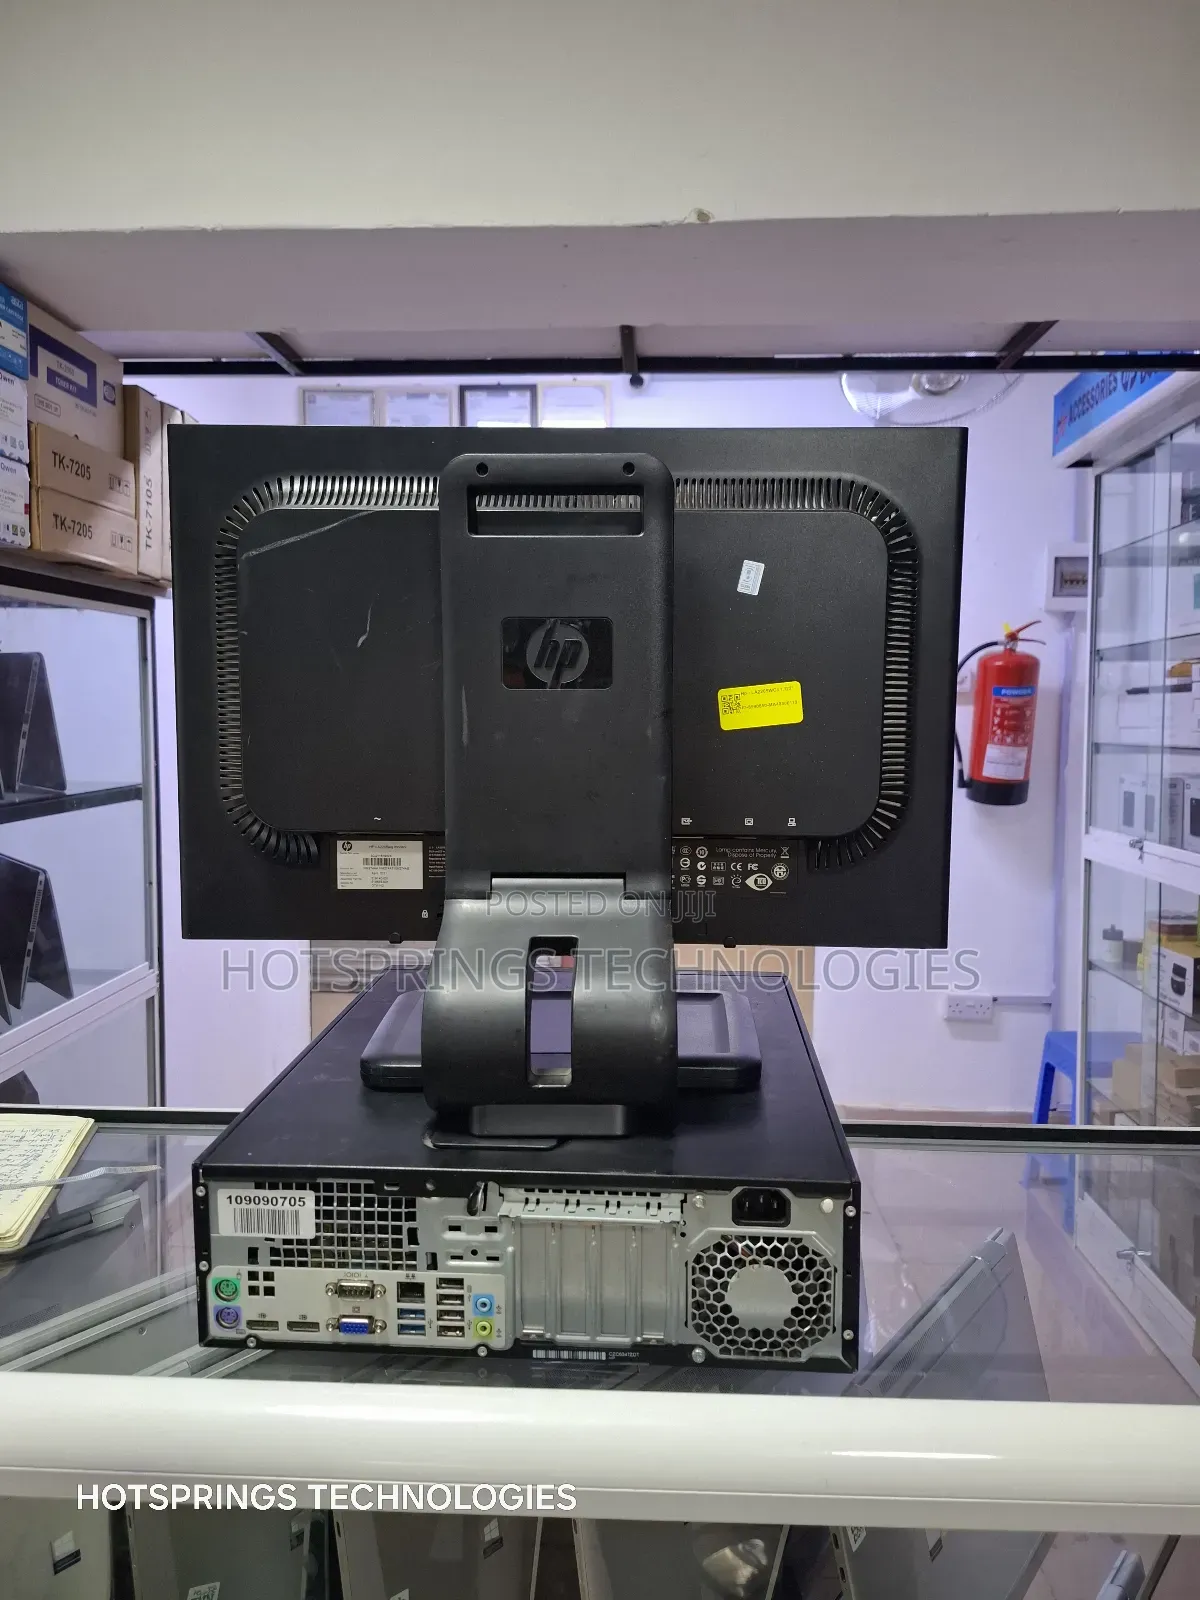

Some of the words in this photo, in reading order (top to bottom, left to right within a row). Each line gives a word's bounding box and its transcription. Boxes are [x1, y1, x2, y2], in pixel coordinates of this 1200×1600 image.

[1068, 372, 1118, 427] ACCESSORIES
[51, 450, 91, 480] TK-7205
[52, 512, 93, 540] TK-7205
[145, 476, 153, 550] TK-7105
[527, 619, 589, 690] hp
[730, 862, 743, 871] CE
[227, 1194, 306, 1207] 109090705
